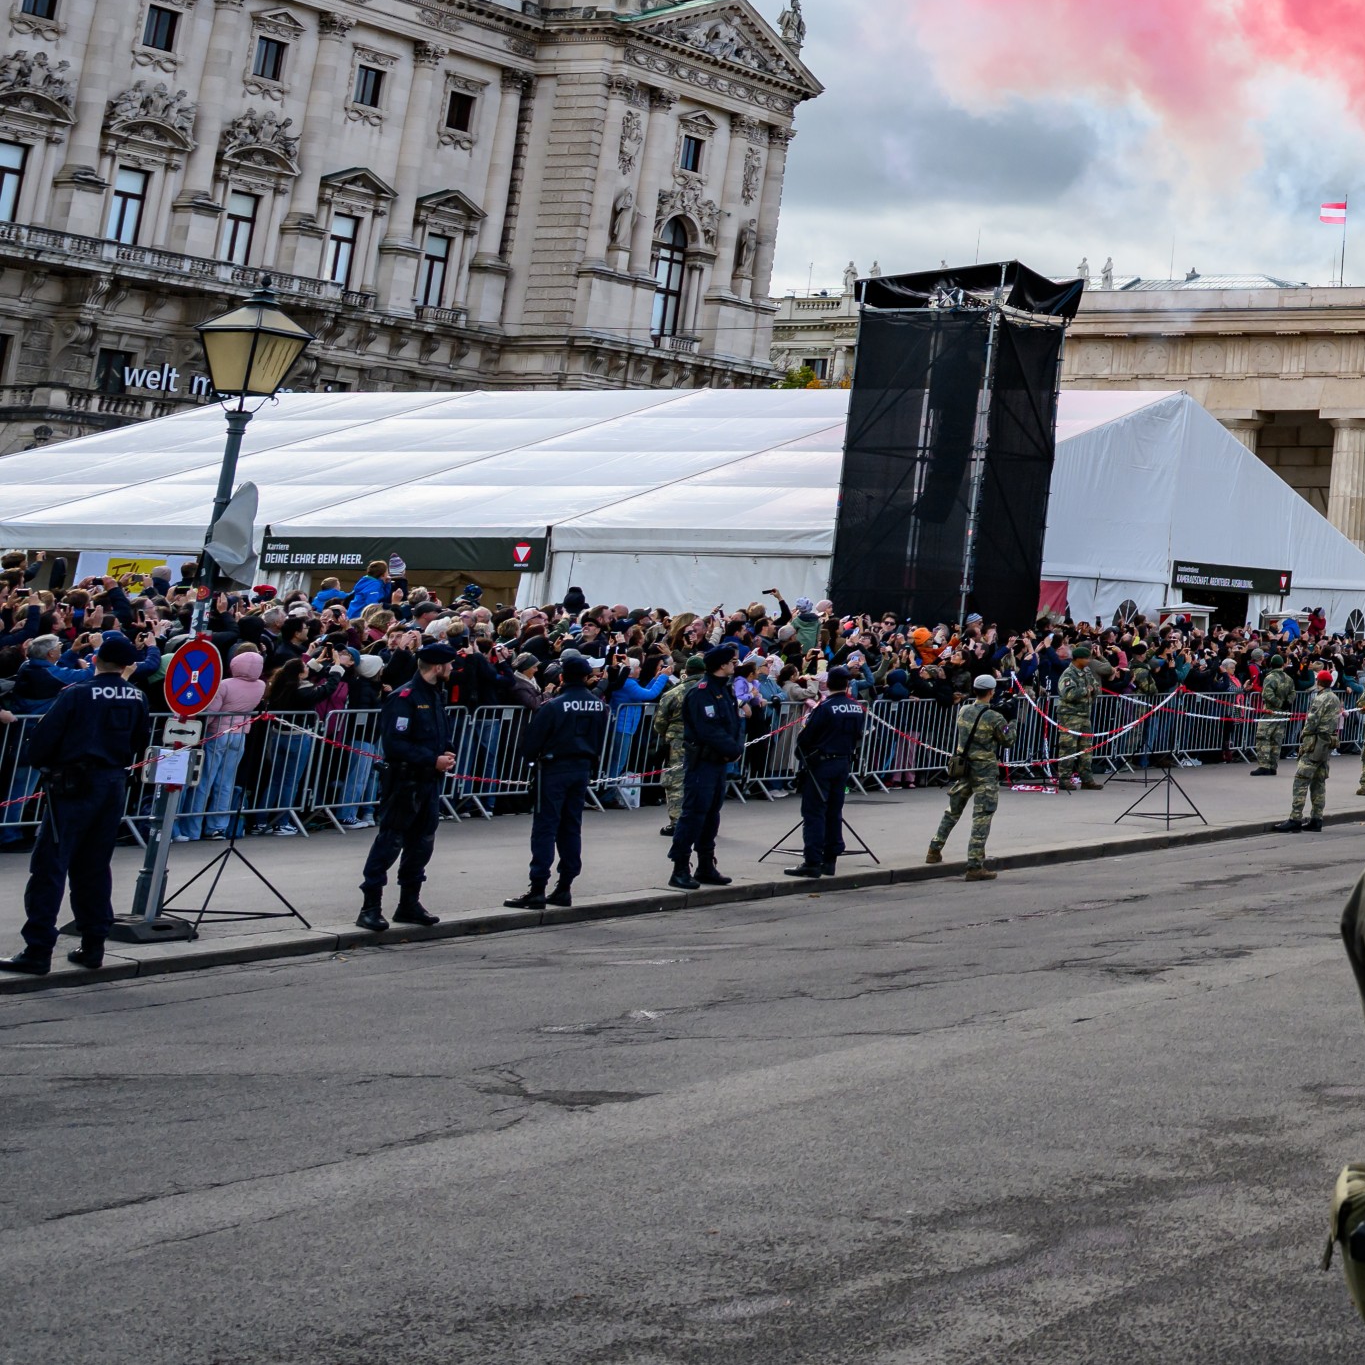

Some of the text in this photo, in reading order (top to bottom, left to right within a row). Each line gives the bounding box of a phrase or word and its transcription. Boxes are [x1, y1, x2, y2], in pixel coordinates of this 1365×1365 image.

[123, 363, 180, 392] welt
[266, 543, 290, 551] Karriere
[265, 553, 364, 565] DEINE LEHRE BEIM HEER.
